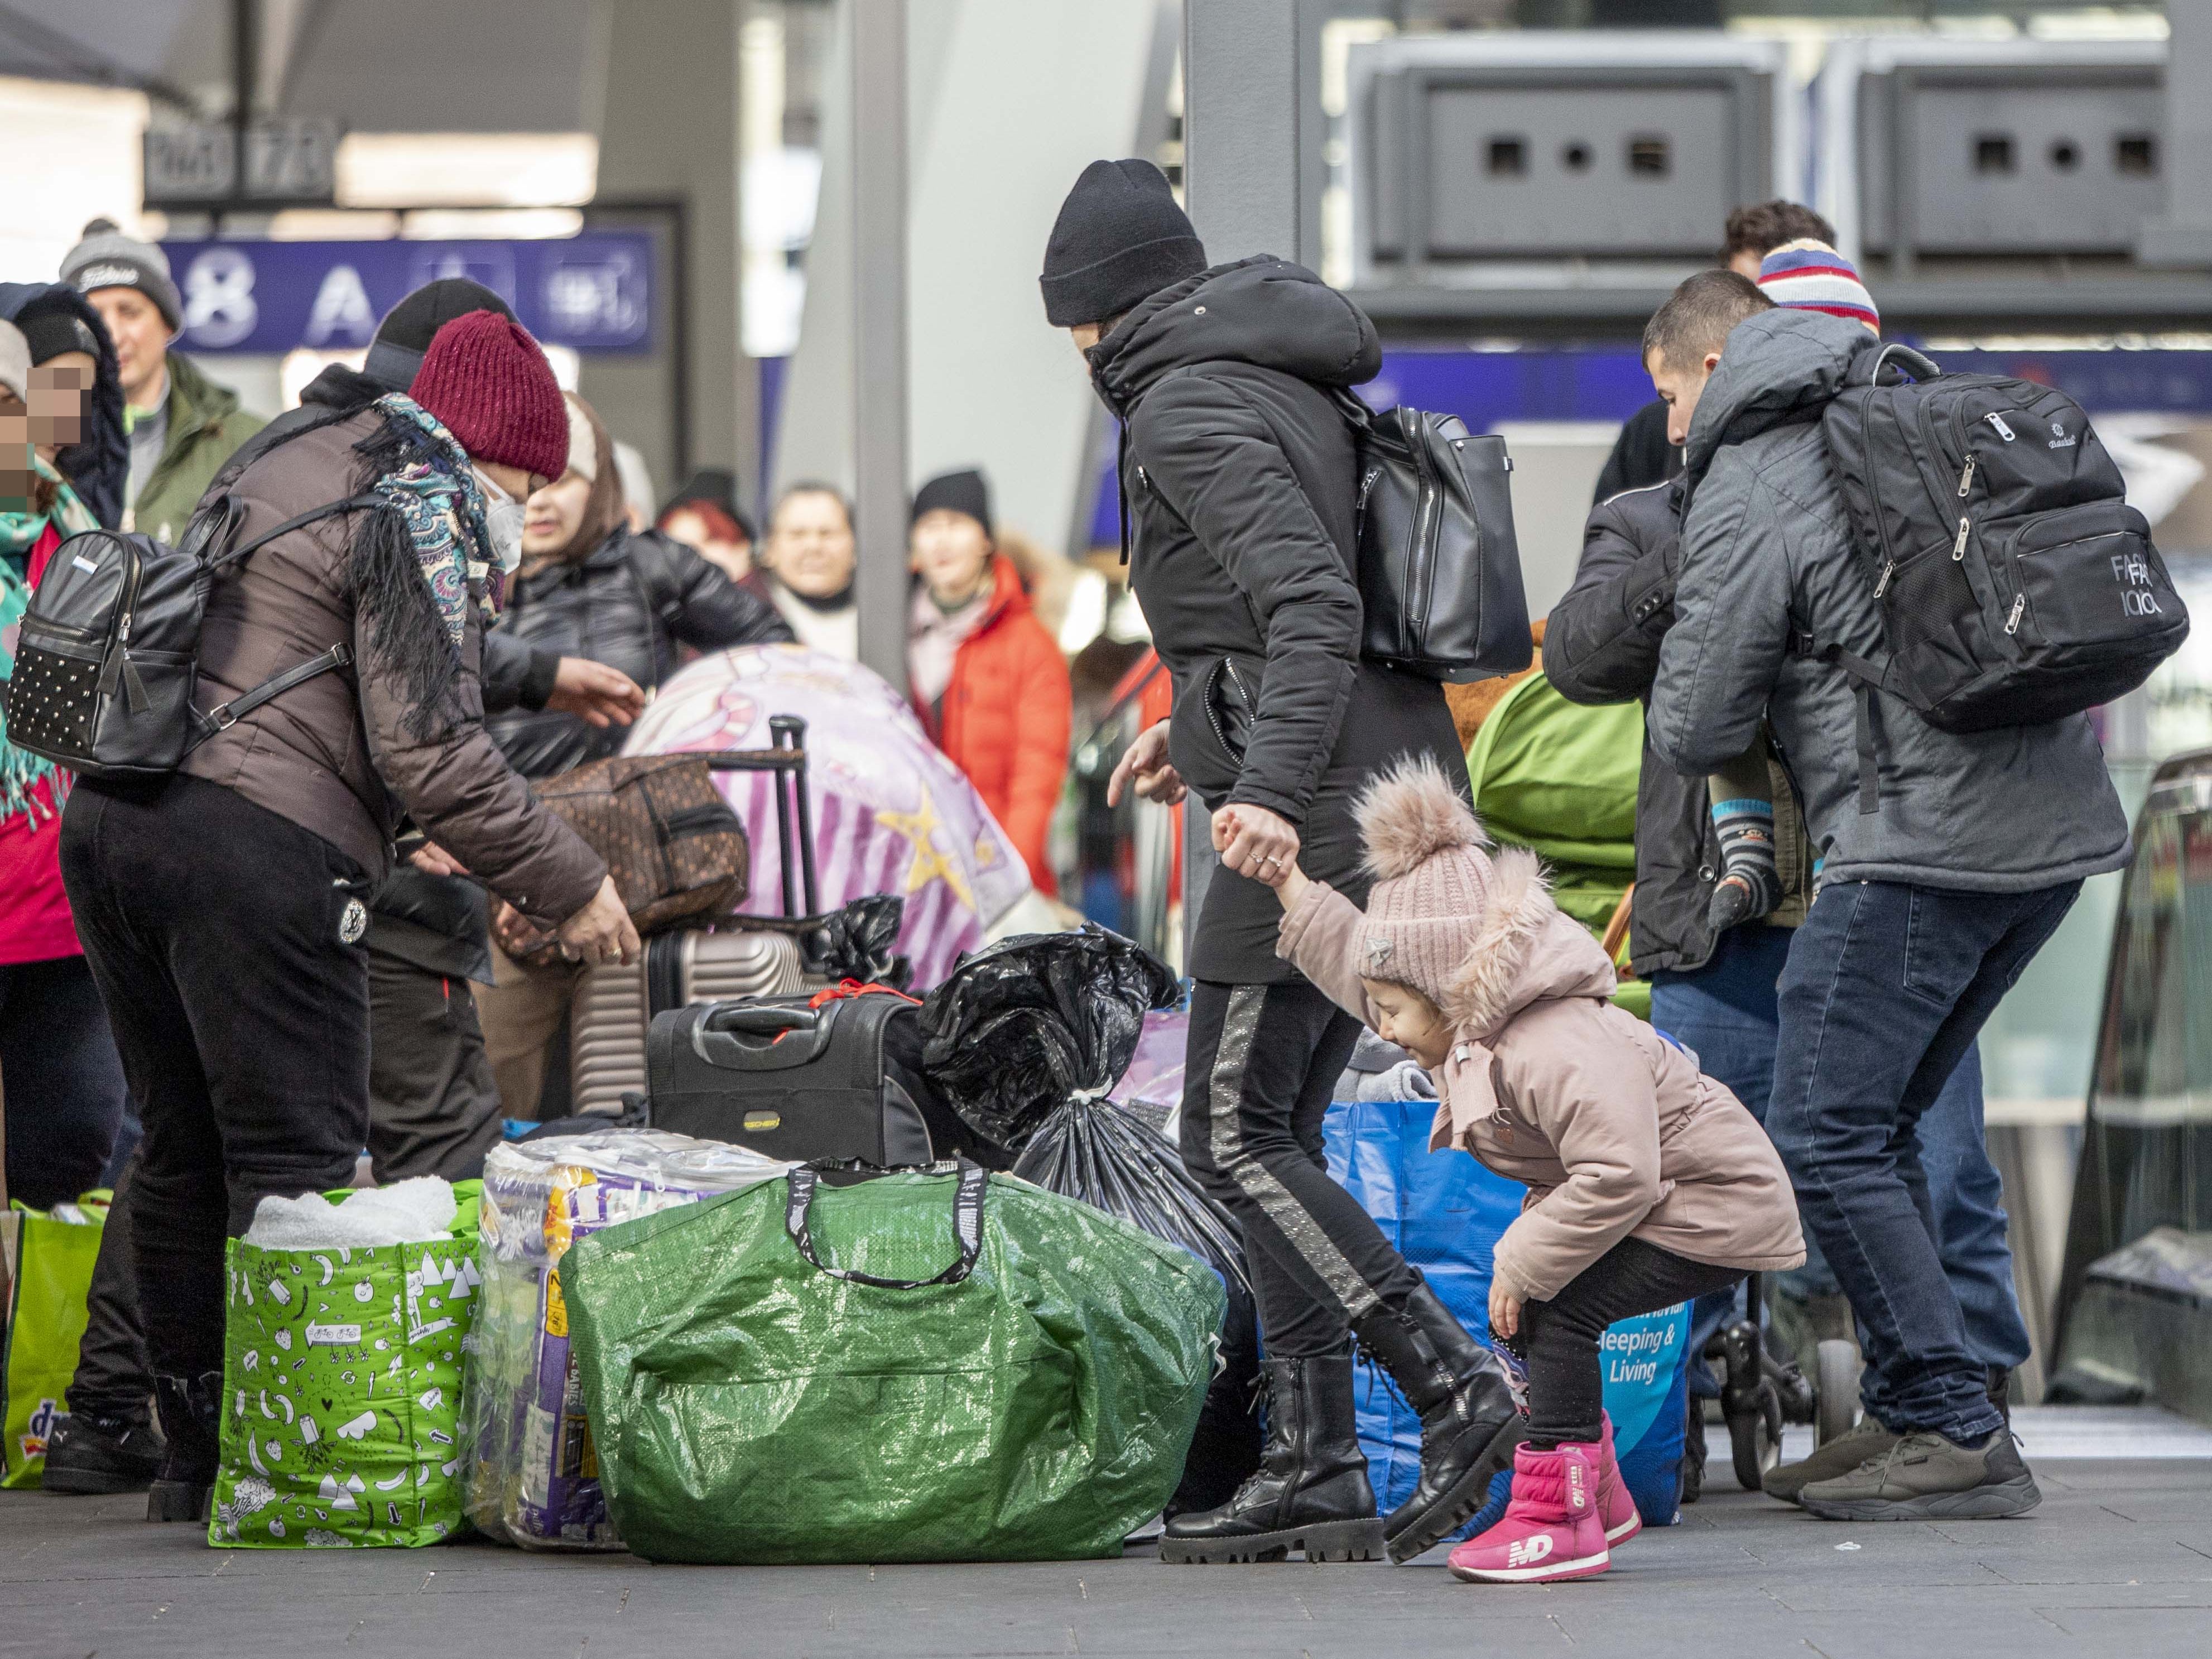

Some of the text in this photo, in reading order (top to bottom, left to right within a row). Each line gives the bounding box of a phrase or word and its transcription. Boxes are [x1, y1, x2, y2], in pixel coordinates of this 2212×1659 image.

[1595, 1323, 1675, 1357] leeping &
[1610, 1358, 1657, 1386] Living
